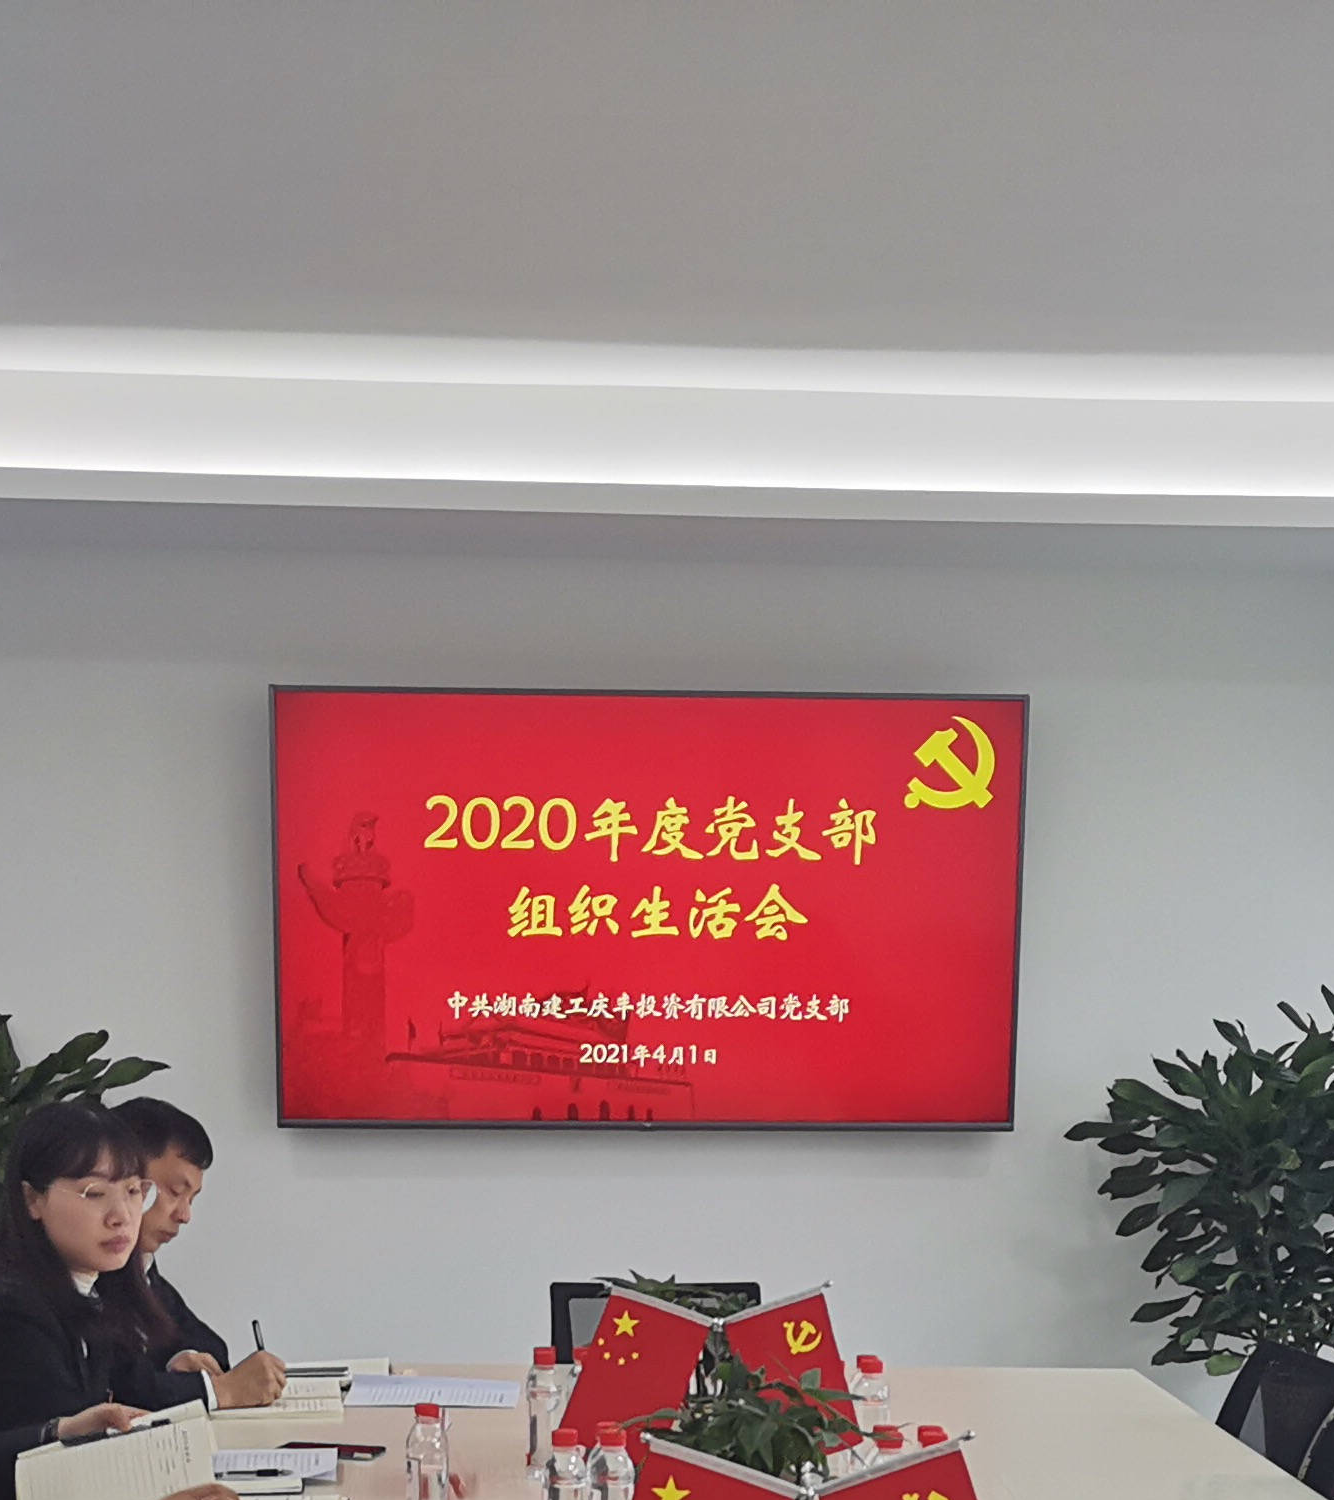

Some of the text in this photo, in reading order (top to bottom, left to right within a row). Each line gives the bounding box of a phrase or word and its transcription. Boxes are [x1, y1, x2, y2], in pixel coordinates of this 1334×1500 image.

[424, 794, 877, 866] 2020年度党支部
[507, 883, 809, 941] 组织生活会
[447, 990, 850, 1023] 中共湖南建工庆丰投资有限公司党支部
[579, 1043, 717, 1068] 2021年4月1日
